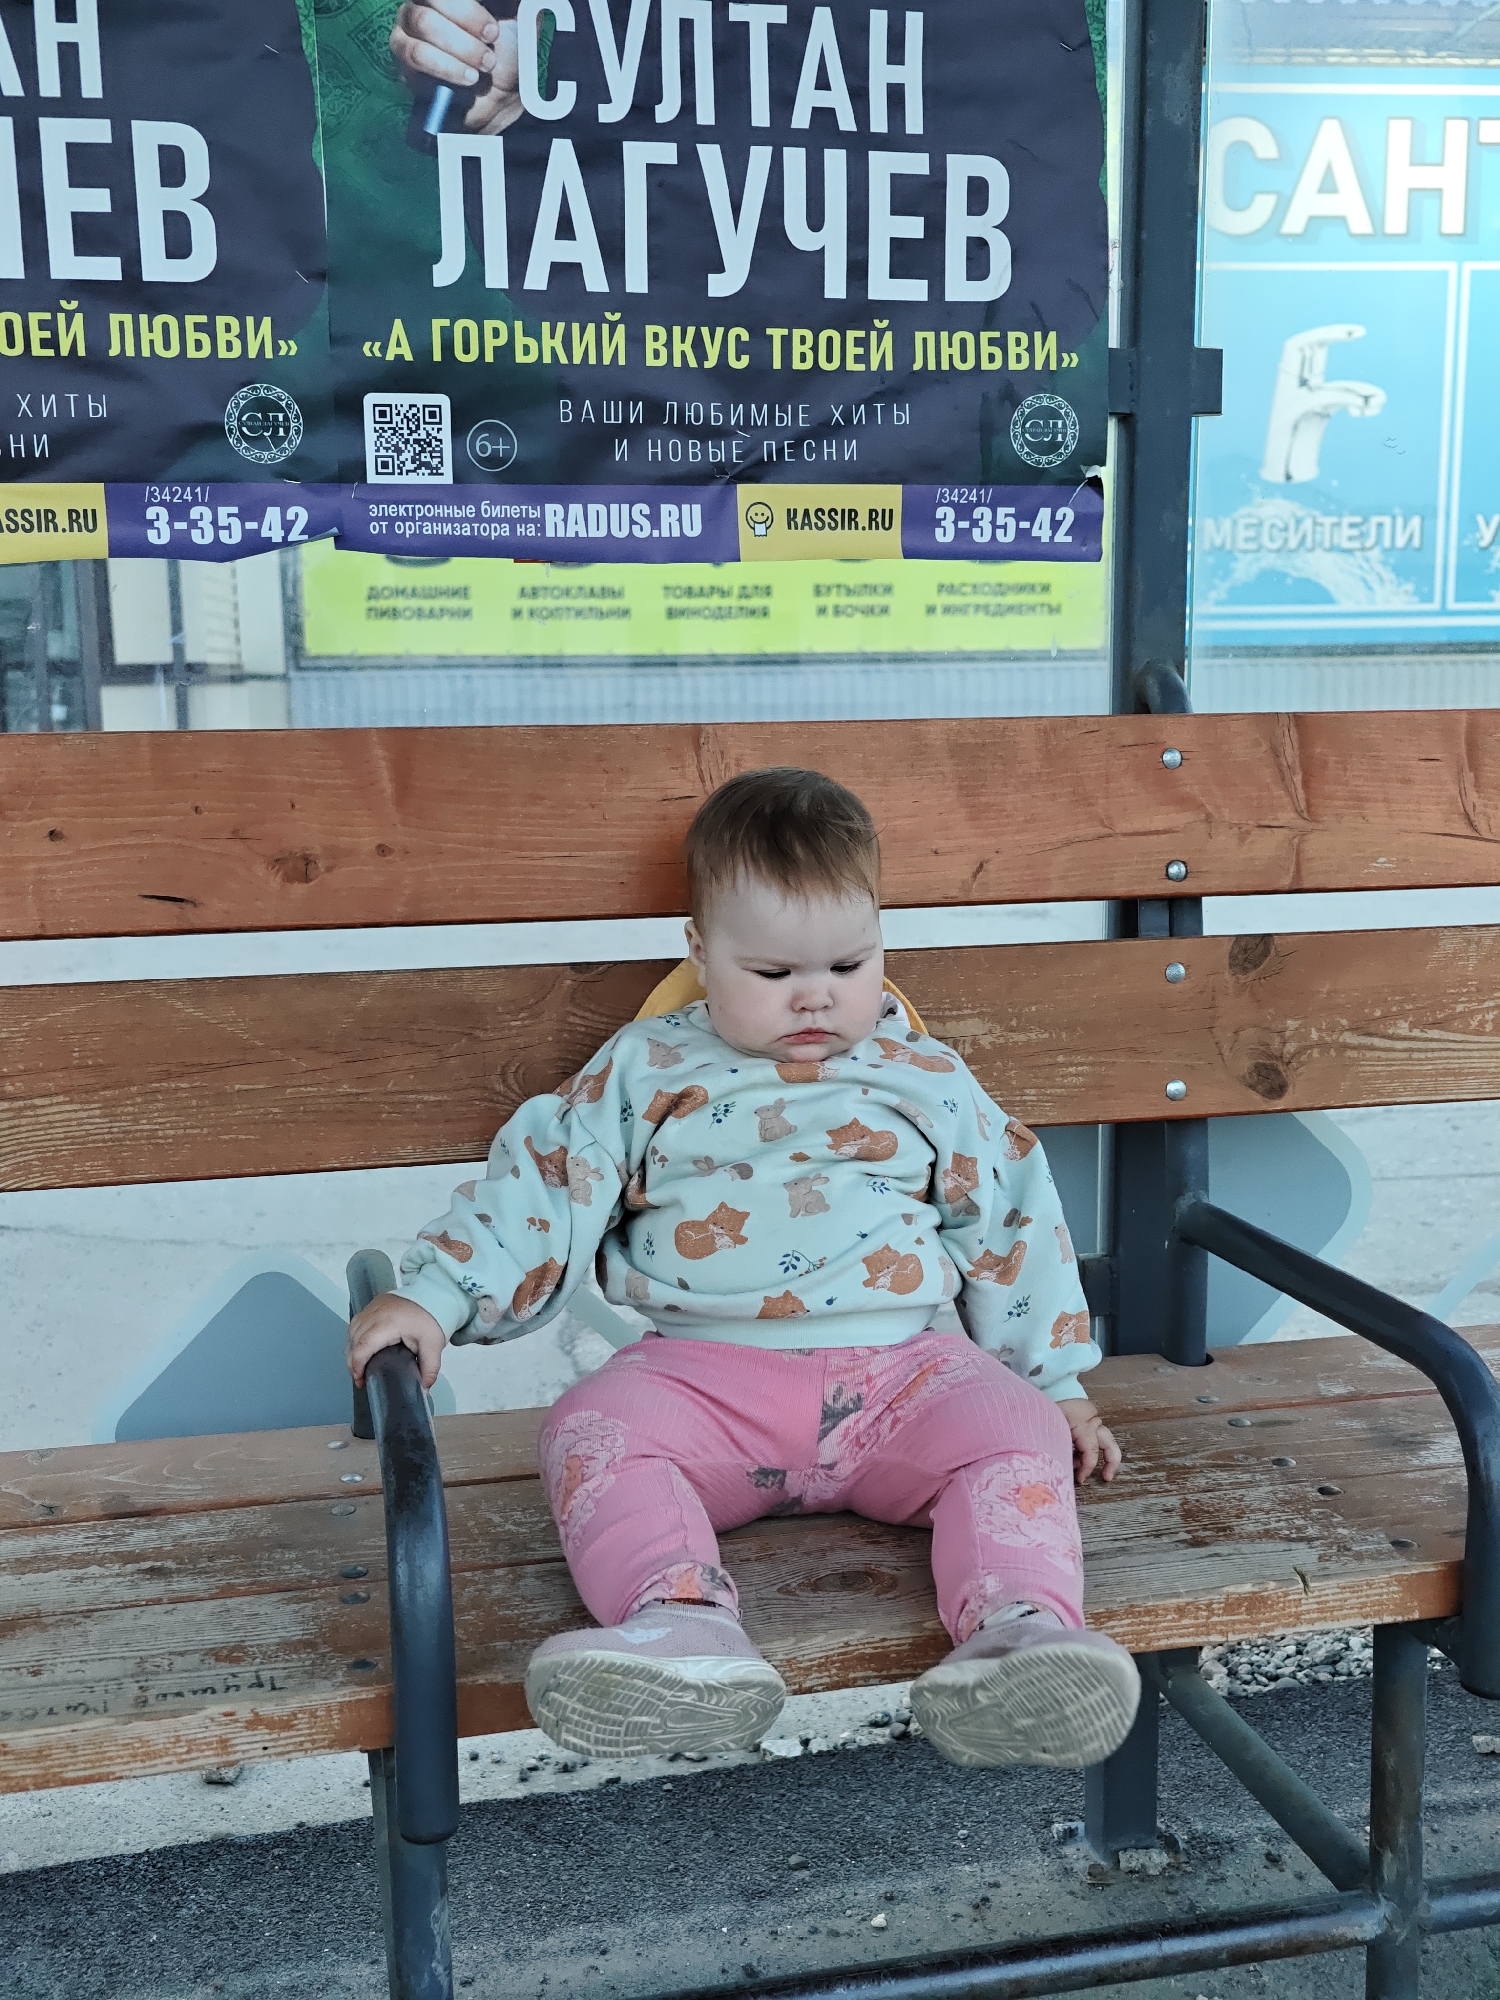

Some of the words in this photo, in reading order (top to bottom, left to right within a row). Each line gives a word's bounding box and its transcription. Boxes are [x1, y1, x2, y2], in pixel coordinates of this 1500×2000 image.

[517, 0, 923, 134] СУЛТАН
[1206, 116, 1500, 236] САН
[433, 133, 1011, 302] ЛАГУЧЕВ
[108, 313, 298, 359] ЛЮБВИ»
[363, 319, 414, 361] «А
[431, 312, 626, 365] ГОРЬКИЙ
[645, 325, 750, 369] ВКУС
[766, 319, 893, 371] ТВОЕЙ
[912, 330, 1079, 371] ЛЮБВИ»
[16, 393, 107, 418] ХИТЫ
[559, 399, 644, 424] ВАШИ
[663, 401, 811, 427] ЛЮБИМЫЕ
[831, 403, 911, 426] ХИТЫ
[0, 433, 50, 458] НИ
[475, 433, 511, 458] 6+
[614, 438, 629, 462] И
[648, 439, 745, 463] НОВЫЕ
[763, 439, 858, 462] ПЕСНИ
[145, 506, 309, 545] 3-35-42
[368, 502, 476, 520] электронные
[480, 500, 541, 519] билеты
[545, 502, 703, 539] RADUS.RU
[786, 507, 895, 533] KASSIR.RU
[934, 506, 1075, 543] 3-35-42
[369, 521, 389, 535] от
[394, 520, 510, 540] организатора
[516, 521, 541, 537] на:
